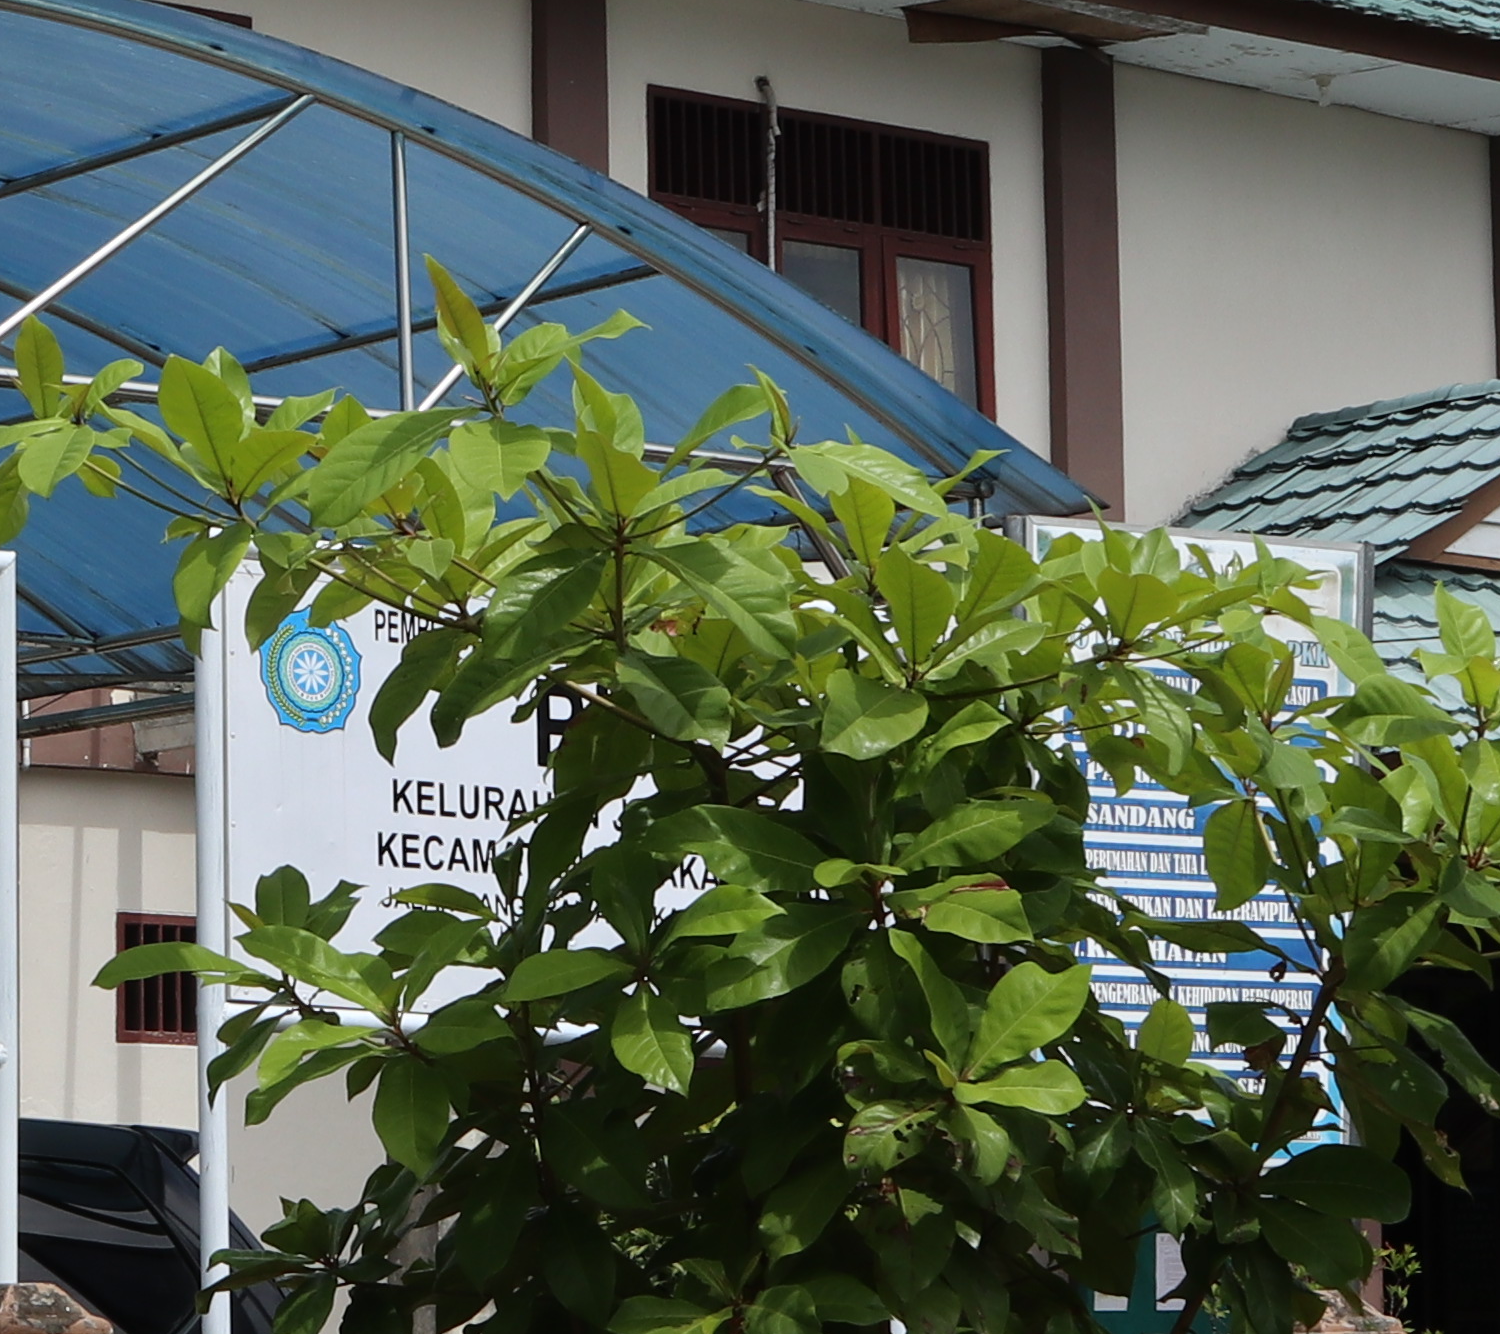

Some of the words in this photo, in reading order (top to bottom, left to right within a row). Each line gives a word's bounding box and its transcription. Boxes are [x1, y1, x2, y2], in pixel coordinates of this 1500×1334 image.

[1086, 802, 1196, 830] SANDANG
[1085, 848, 1149, 873] PERUMAHAN
[1150, 852, 1171, 873] DAN
[1173, 853, 1198, 875] TATA
[1174, 897, 1204, 919] DAN
